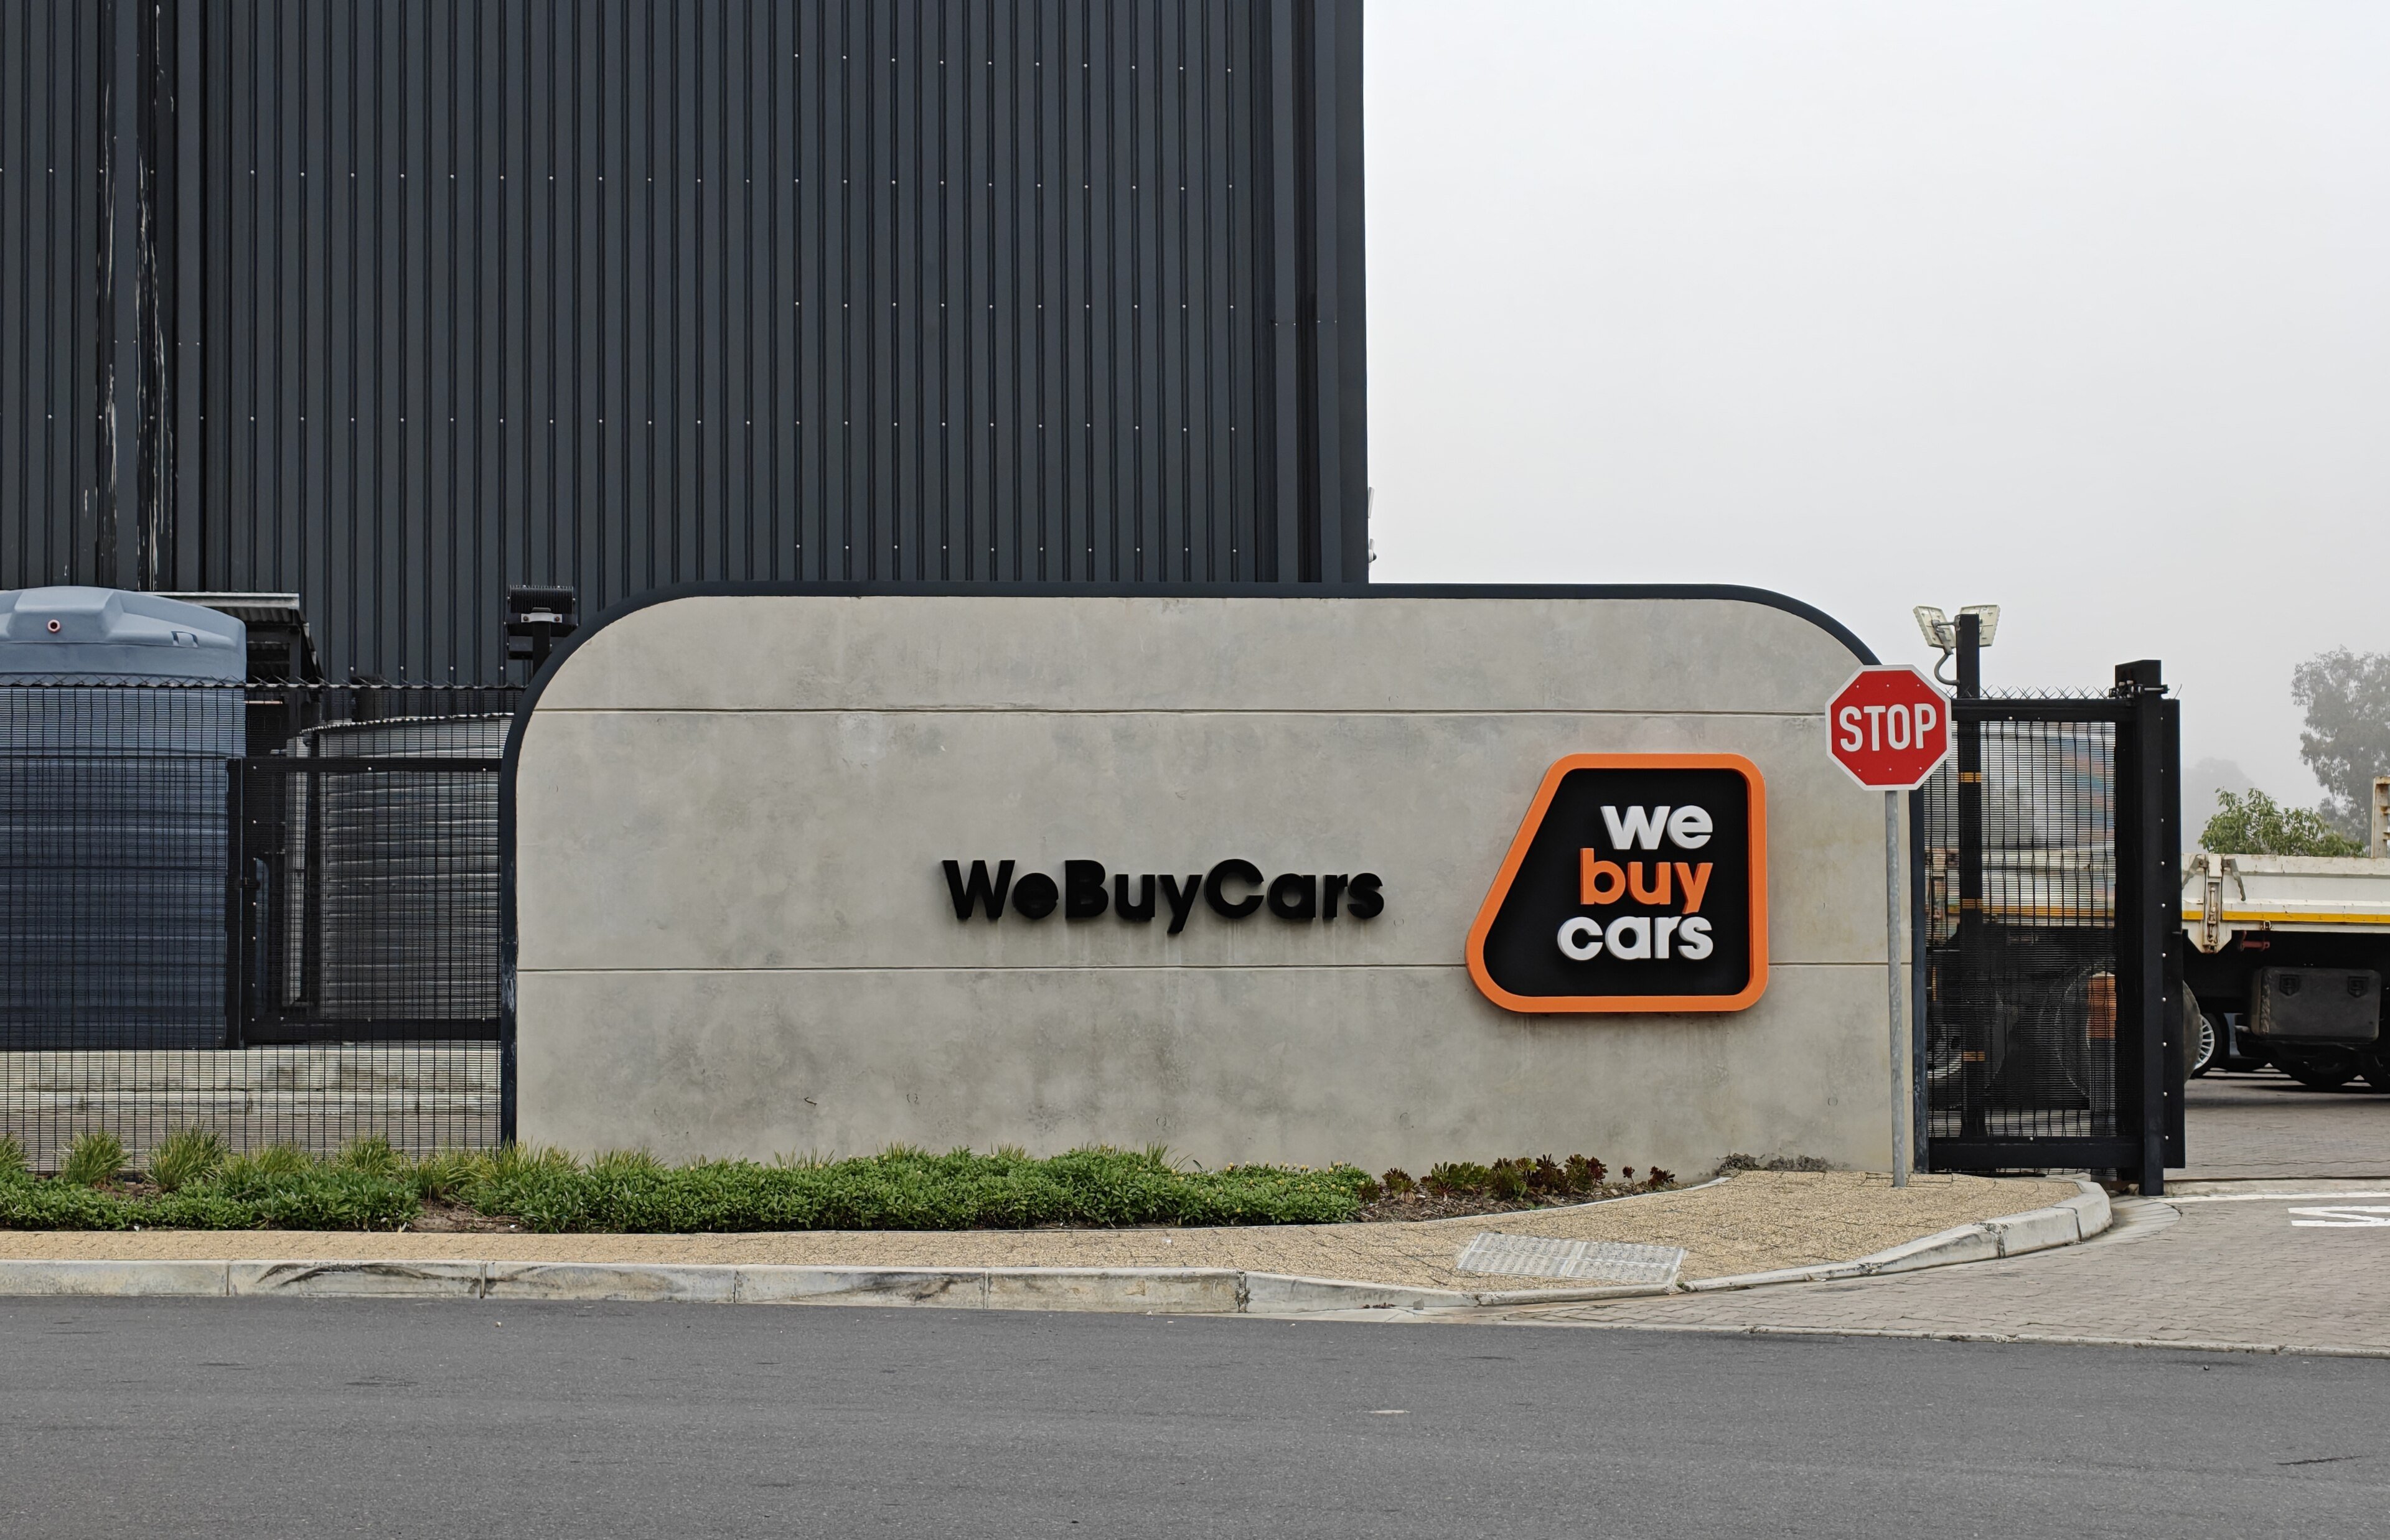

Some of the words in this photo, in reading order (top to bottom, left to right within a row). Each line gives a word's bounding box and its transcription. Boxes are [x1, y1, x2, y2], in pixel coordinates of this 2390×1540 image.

[1839, 703, 1937, 752] STOP
[1600, 805, 1713, 850] we
[942, 859, 1385, 935] WeBuyCars
[1580, 848, 1713, 914] buy
[1557, 916, 1713, 961] cars
